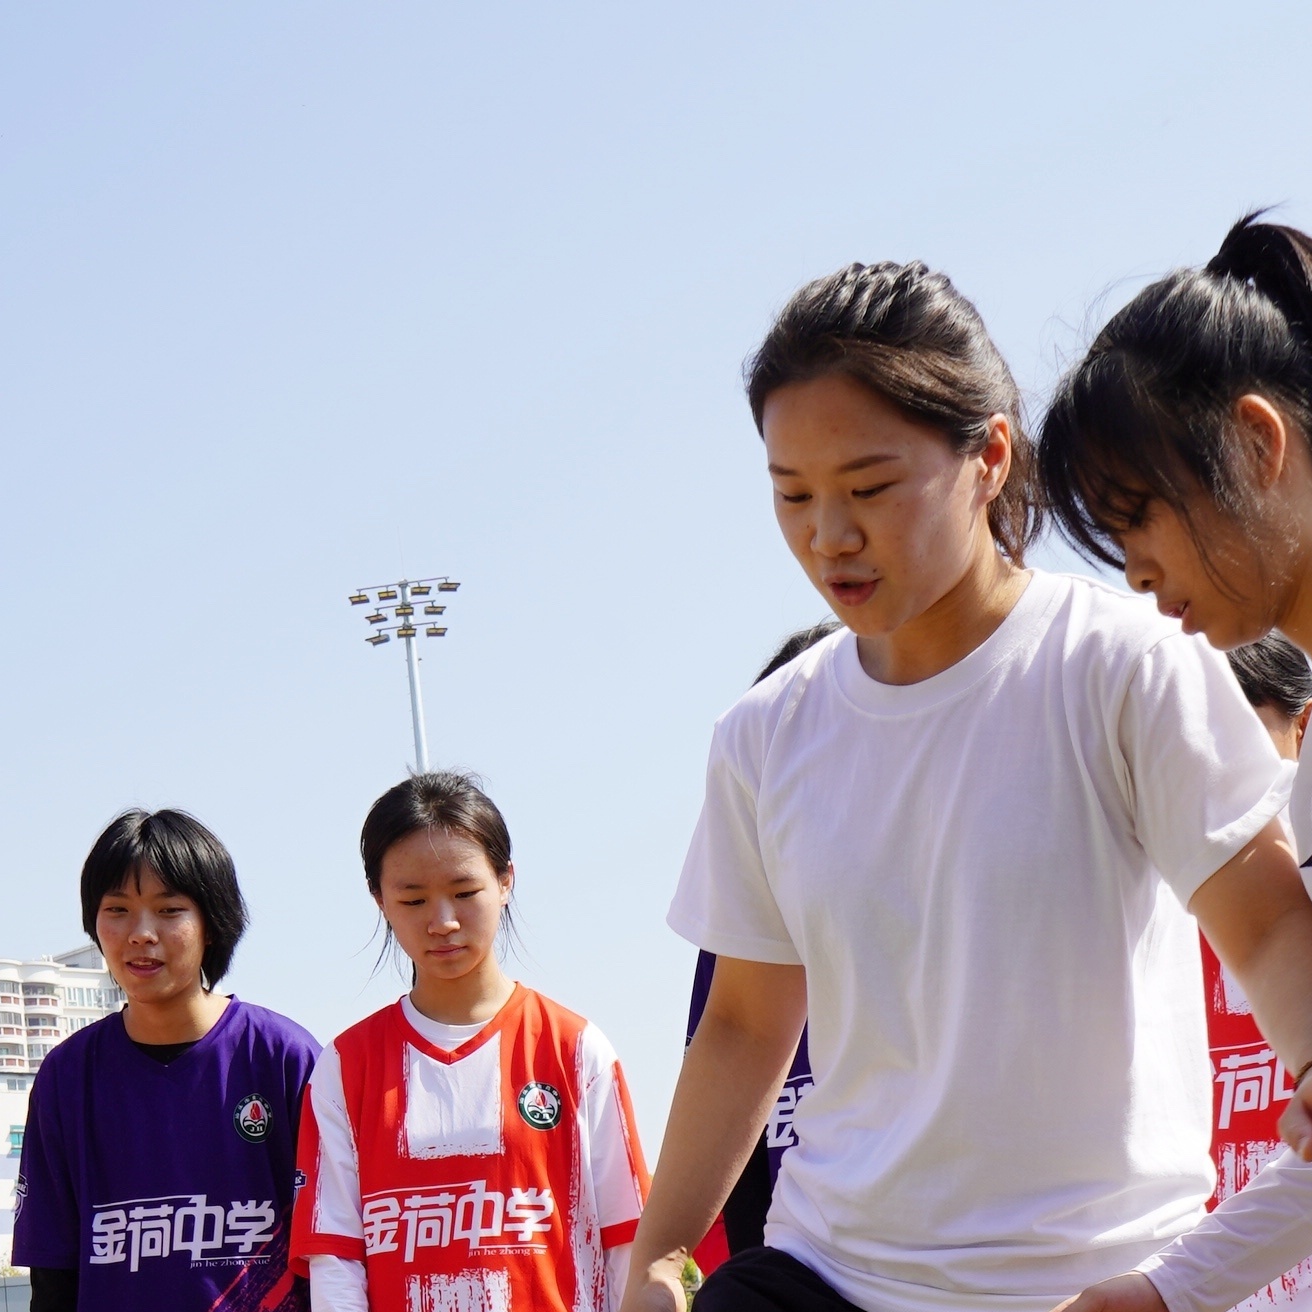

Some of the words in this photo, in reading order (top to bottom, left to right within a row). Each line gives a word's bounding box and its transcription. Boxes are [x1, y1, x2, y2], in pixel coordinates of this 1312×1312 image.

[89, 1194, 276, 1273] 金荷中学
[362, 1179, 555, 1263] 金荷中学
[190, 1259, 203, 1270] jin
[205, 1259, 218, 1268] he
[220, 1258, 251, 1268] zhong
[484, 1247, 497, 1256] he
[499, 1247, 531, 1256] zhong
